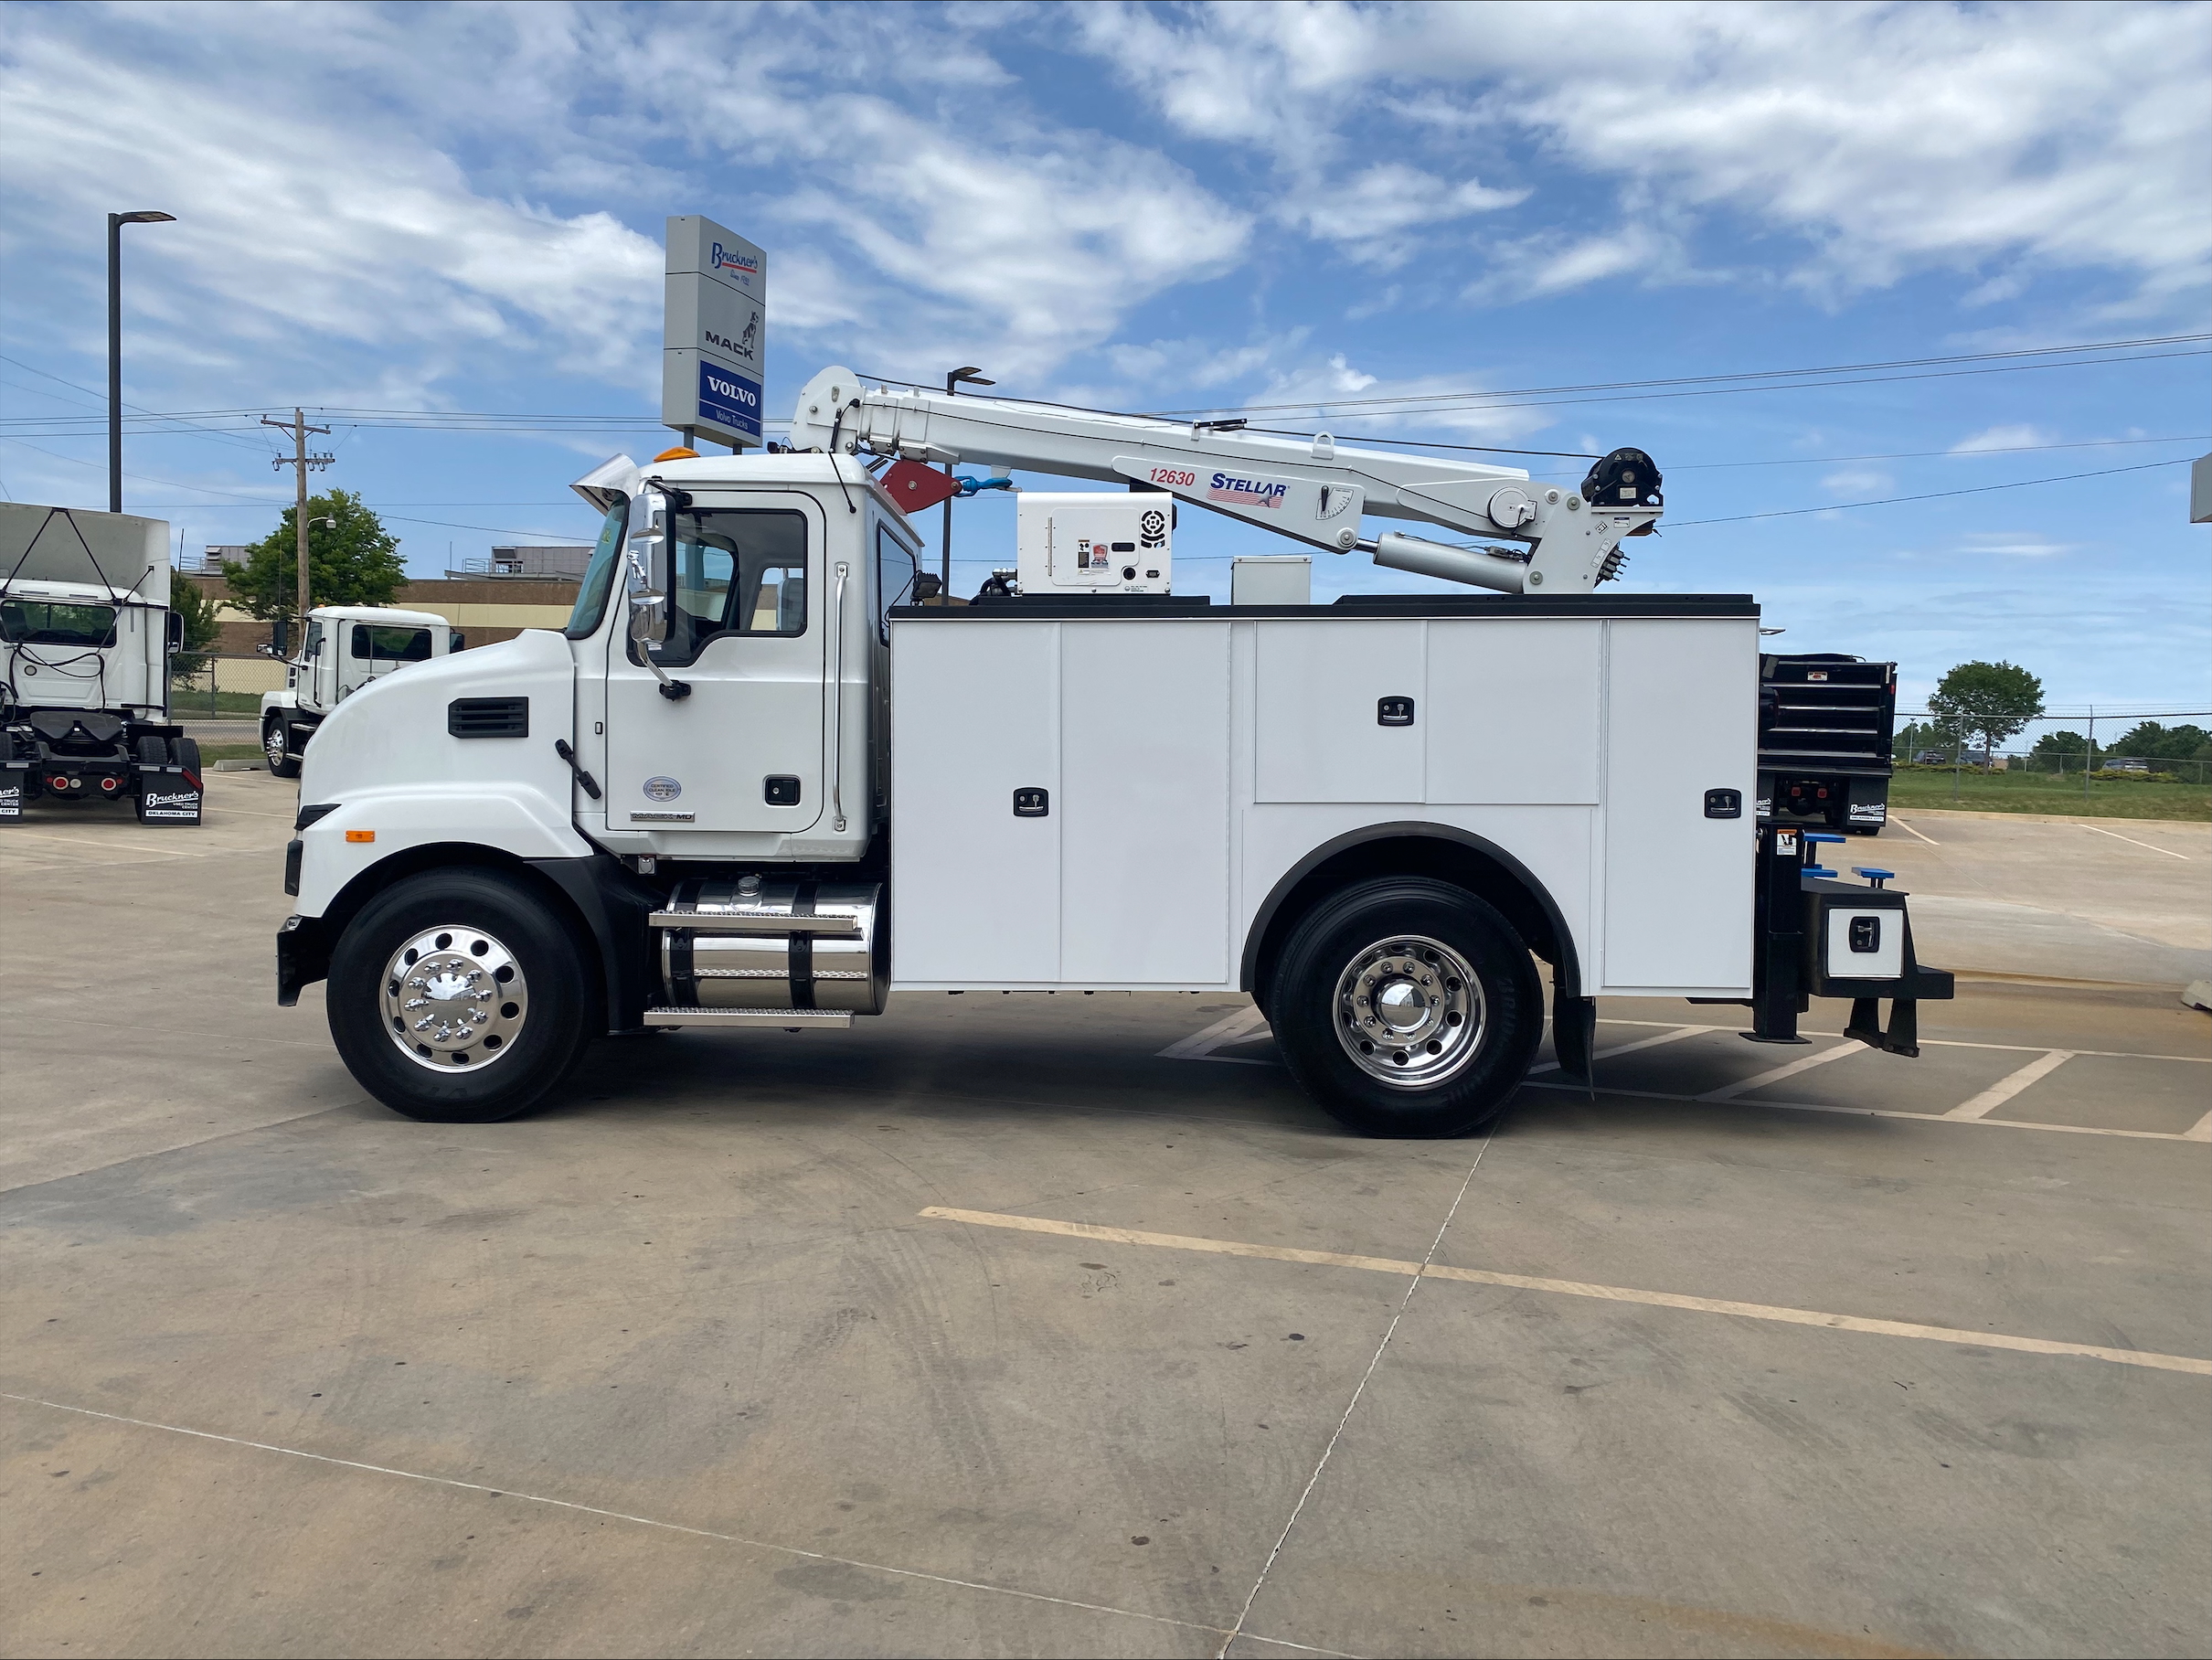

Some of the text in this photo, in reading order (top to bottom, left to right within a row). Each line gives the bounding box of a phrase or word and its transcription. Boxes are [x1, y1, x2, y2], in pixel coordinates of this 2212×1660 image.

[711, 242, 759, 270] Bruckner's
[706, 330, 754, 361] MACK
[707, 376, 757, 407] VOLVO
[716, 410, 749, 430] Volvo Trucks
[1150, 467, 1196, 486] 12630
[145, 791, 199, 807] Bruckner's
